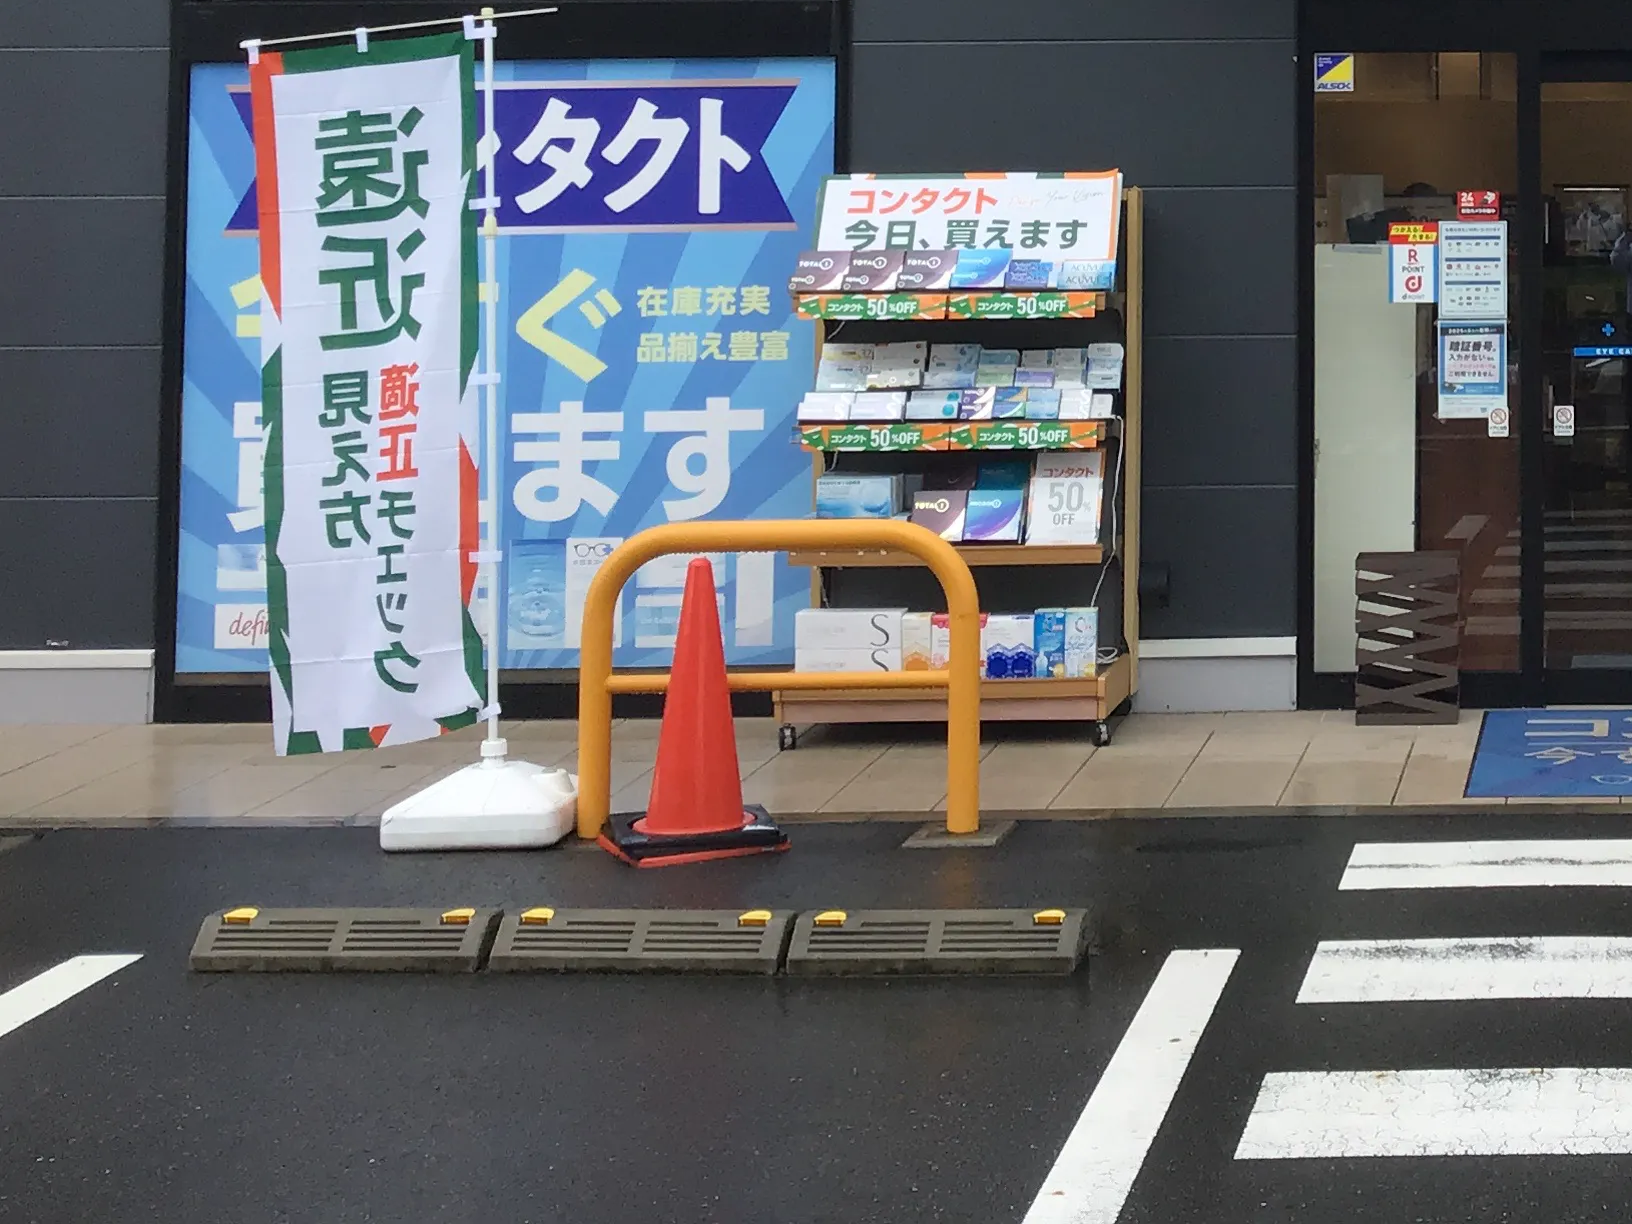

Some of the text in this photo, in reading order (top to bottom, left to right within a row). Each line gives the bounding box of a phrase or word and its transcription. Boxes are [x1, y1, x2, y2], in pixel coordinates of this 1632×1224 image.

[1316, 82, 1352, 90] ALSOK
[477, 96, 751, 214] タクト
[847, 187, 998, 215] コンタクト
[845, 218, 1088, 251] 今日、買えます
[1408, 249, 1418, 262] R
[1402, 265, 1425, 273] POINT
[637, 286, 771, 317] 在庫充実
[828, 303, 864, 312] コンタクト
[978, 302, 1014, 311] コンタクト
[636, 332, 790, 364] 品揃え豊富
[831, 435, 867, 443] コンタクト
[979, 432, 1015, 441] コンタクト
[1043, 467, 1094, 479] コンタクト
[1052, 514, 1076, 526] OFF
[869, 614, 890, 647] S
